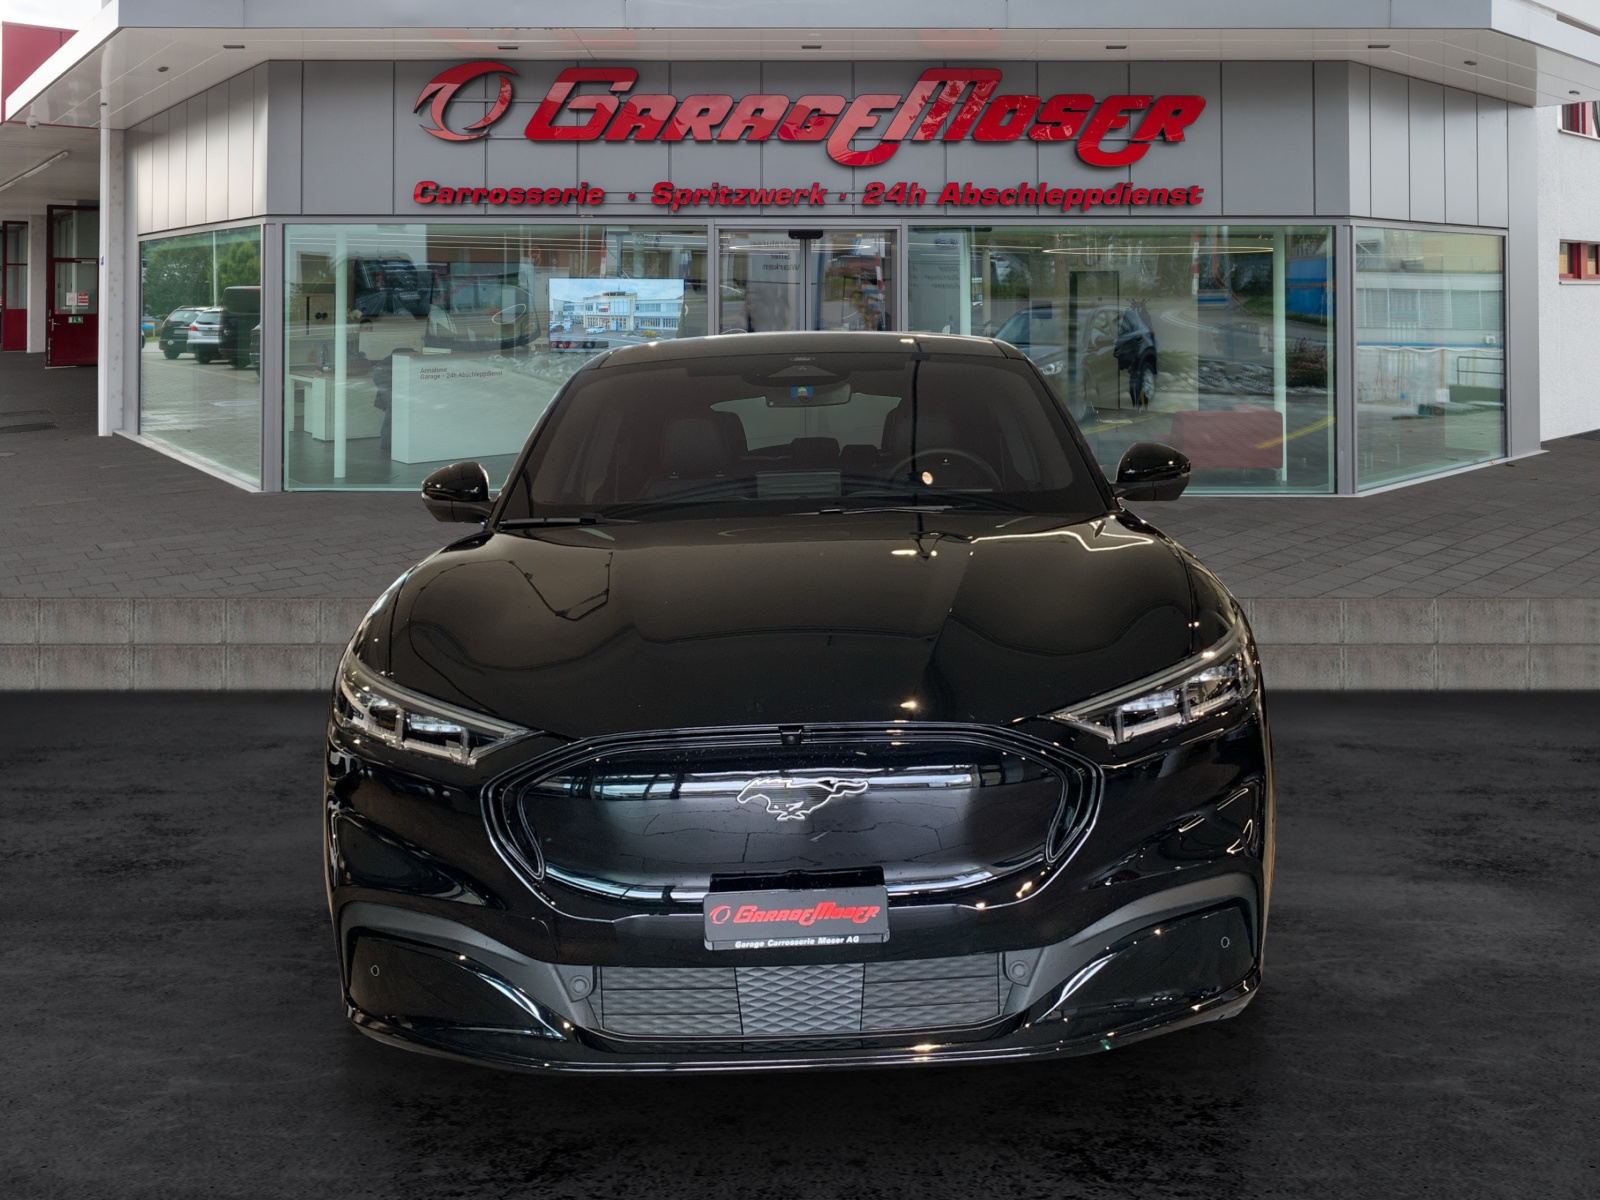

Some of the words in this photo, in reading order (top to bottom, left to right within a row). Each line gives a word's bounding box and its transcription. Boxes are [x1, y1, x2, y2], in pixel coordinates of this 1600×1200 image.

[413, 180, 604, 205] Carrosserie
[651, 181, 826, 211] Spritzwerk
[862, 181, 927, 205] 24h
[937, 181, 1204, 211] Abschleppdienst
[458, 370, 503, 378] Abschleppdienst
[735, 940, 765, 949] Garage
[767, 937, 816, 947] Carrosserie
[817, 936, 845, 945] Moser
[845, 935, 860, 943] AG
